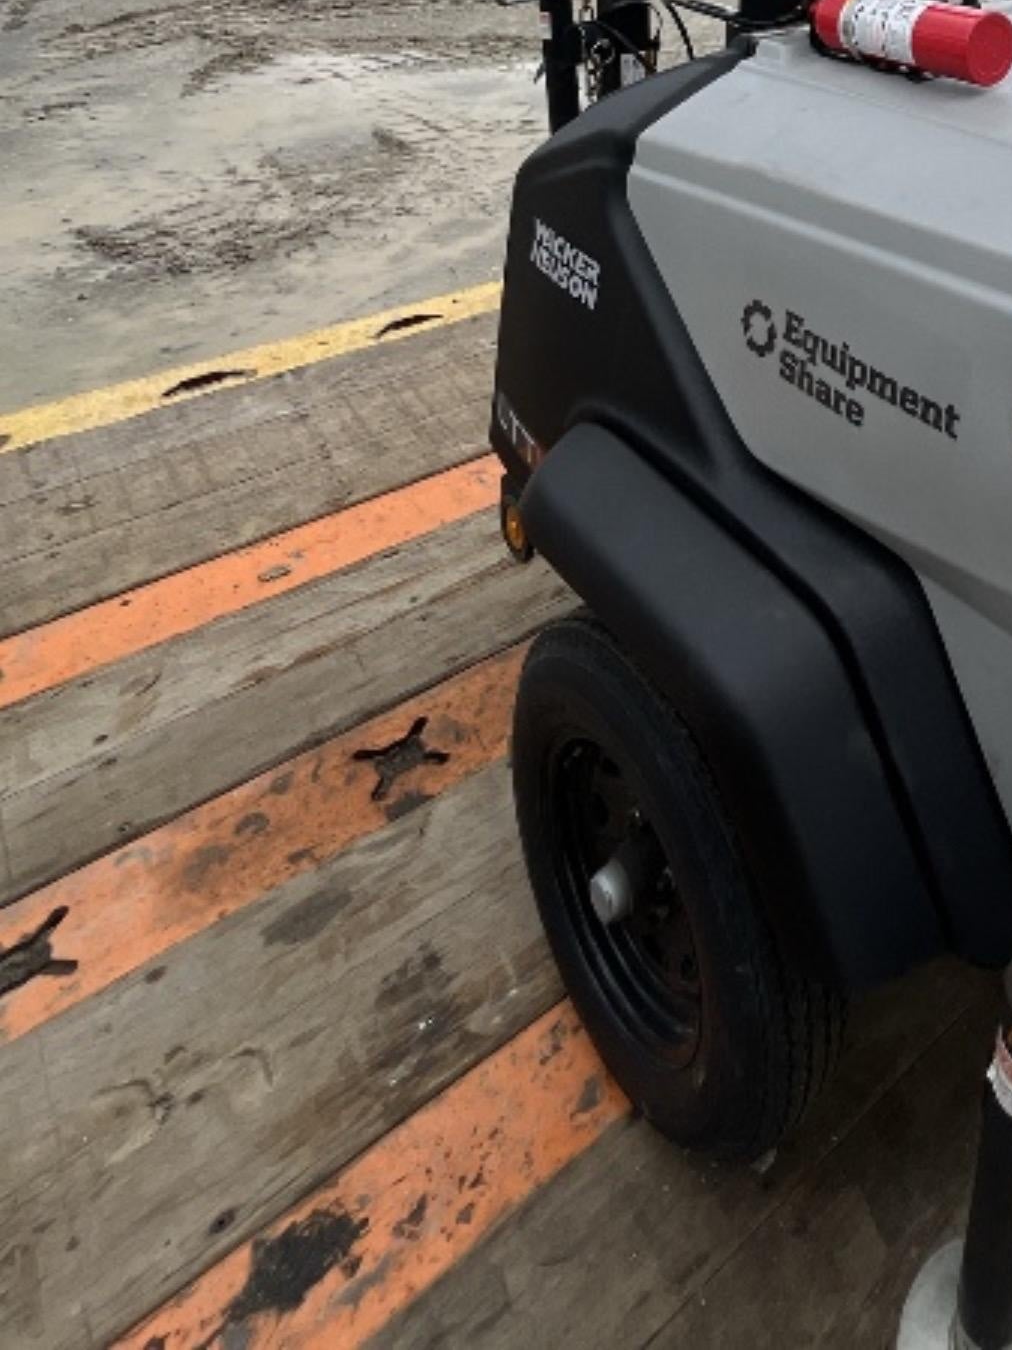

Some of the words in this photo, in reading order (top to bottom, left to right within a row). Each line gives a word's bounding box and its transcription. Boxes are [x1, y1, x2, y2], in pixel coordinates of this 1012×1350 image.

[535, 218, 600, 285] WACKER
[779, 349, 865, 427] Share
[782, 308, 961, 440] Equipment
